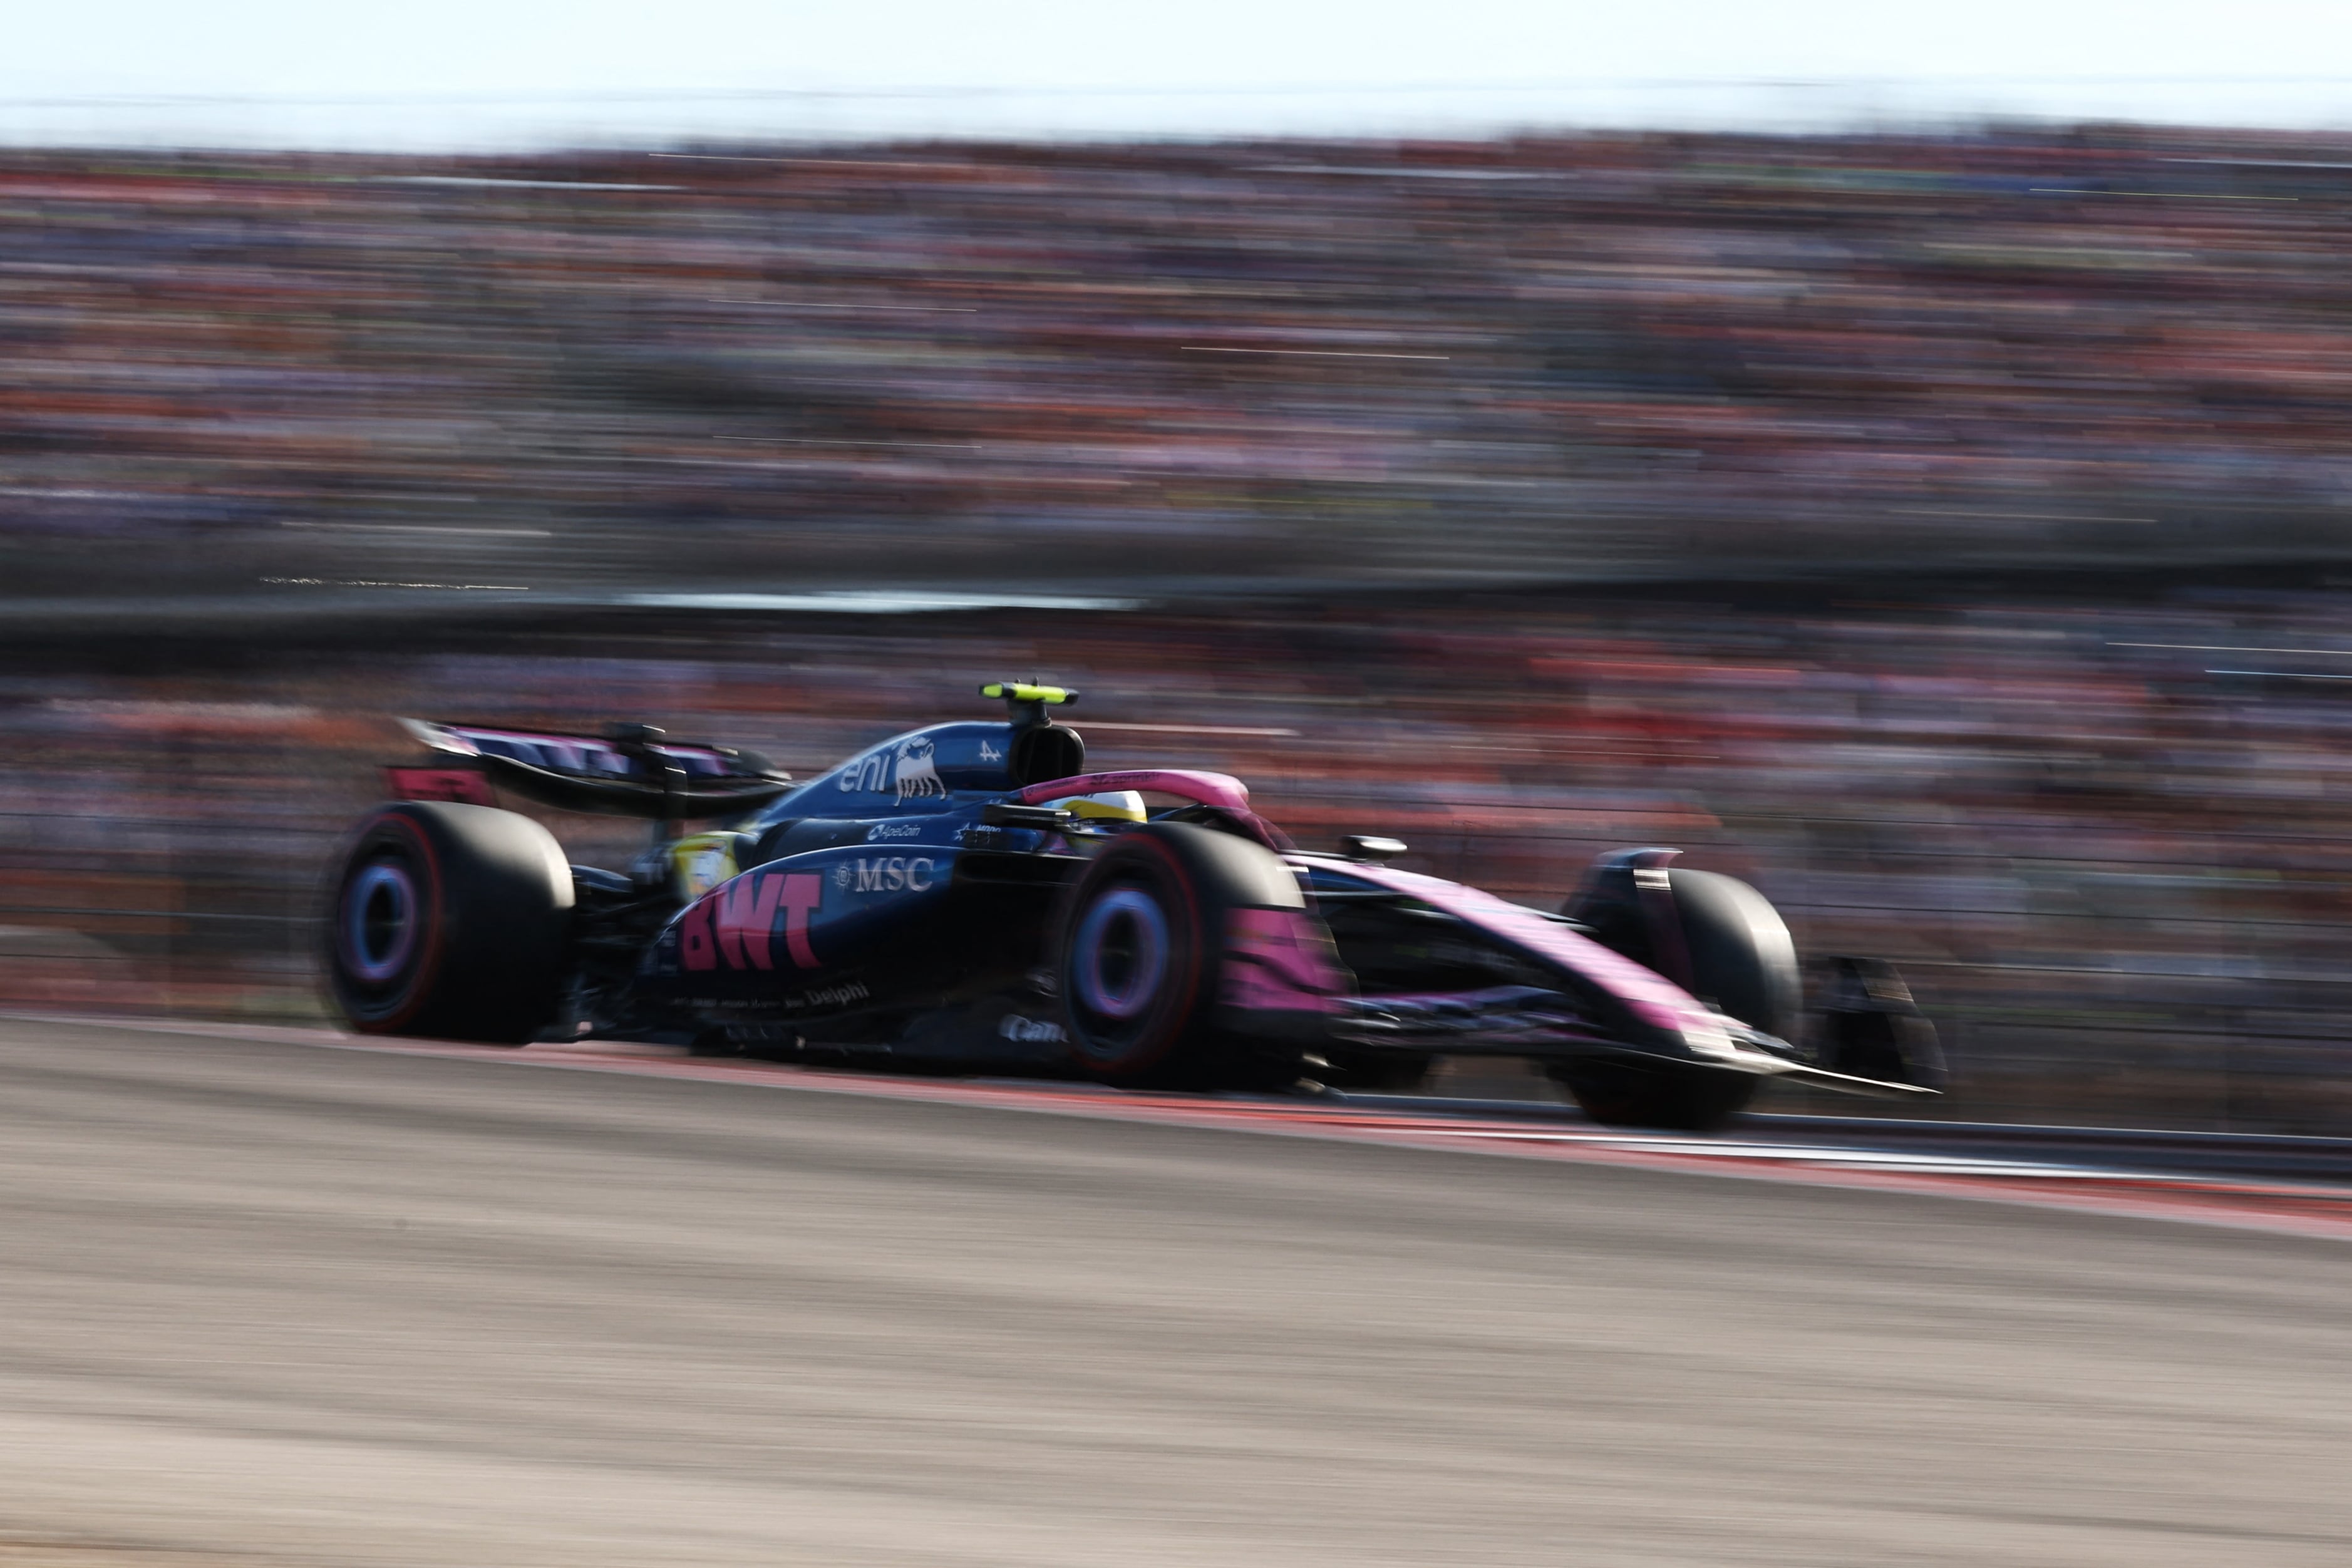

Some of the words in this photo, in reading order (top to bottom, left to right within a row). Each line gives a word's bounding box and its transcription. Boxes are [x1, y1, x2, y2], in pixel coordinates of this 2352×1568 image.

[855, 857, 935, 892] MSC
[683, 874, 822, 971] BWT
[805, 980, 870, 1006] Delphi
